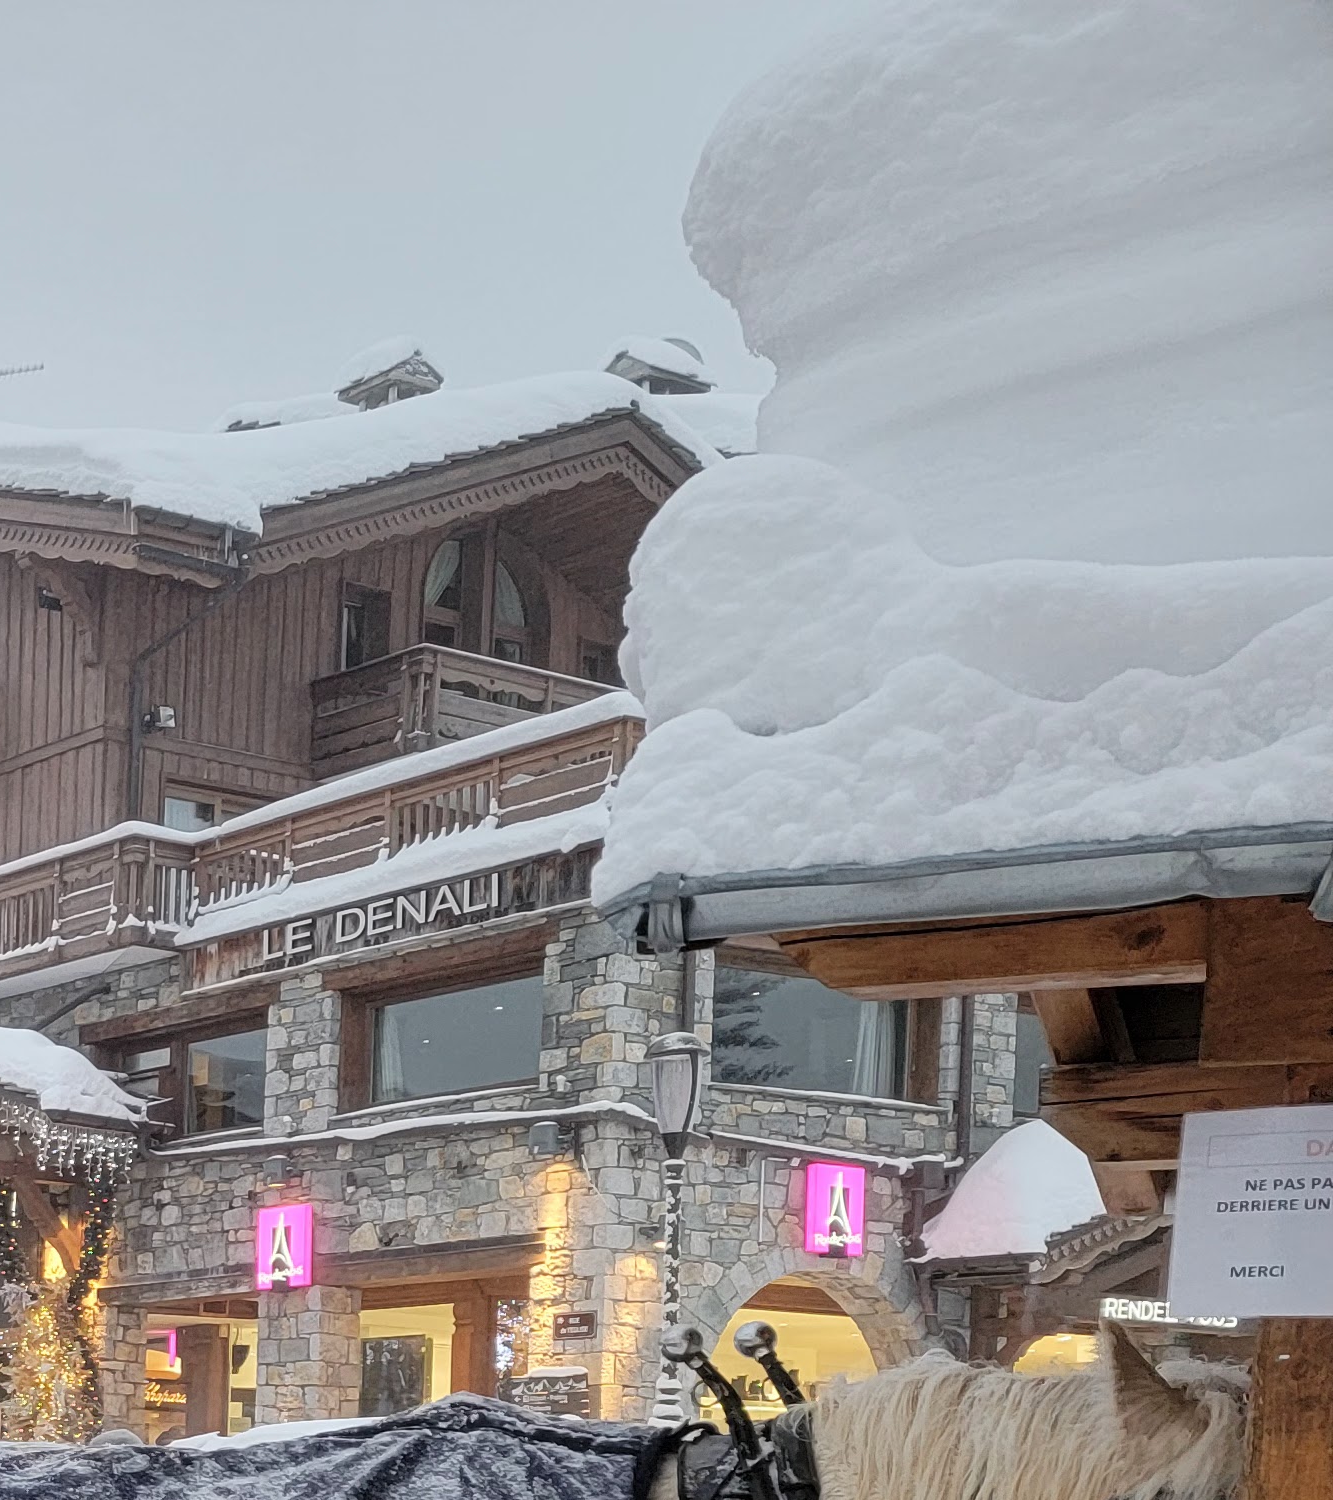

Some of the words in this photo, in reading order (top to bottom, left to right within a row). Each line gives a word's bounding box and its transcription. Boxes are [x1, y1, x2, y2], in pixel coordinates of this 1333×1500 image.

[263, 918, 312, 960] LE
[335, 872, 498, 944] DENALI
[1245, 1179, 1267, 1191] NE
[1273, 1178, 1305, 1190] PAS
[1216, 1199, 1299, 1212] DERRIERE
[1304, 1198, 1330, 1210] UN
[1230, 1265, 1285, 1278] MERCI
